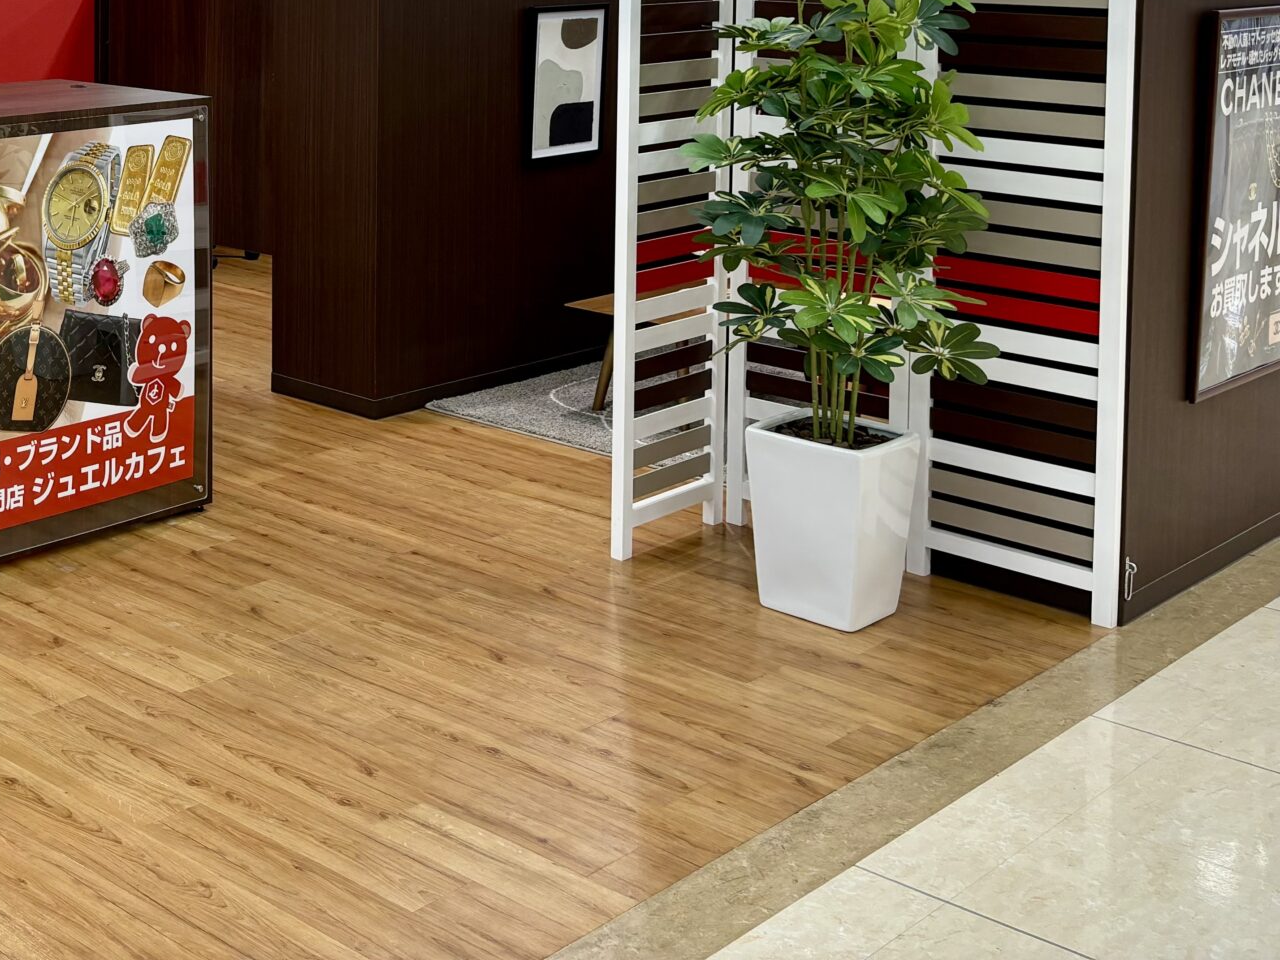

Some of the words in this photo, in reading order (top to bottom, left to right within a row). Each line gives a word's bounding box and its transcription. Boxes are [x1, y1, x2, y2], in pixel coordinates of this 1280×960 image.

[32, 445, 186, 506] ジュエルカフェ
